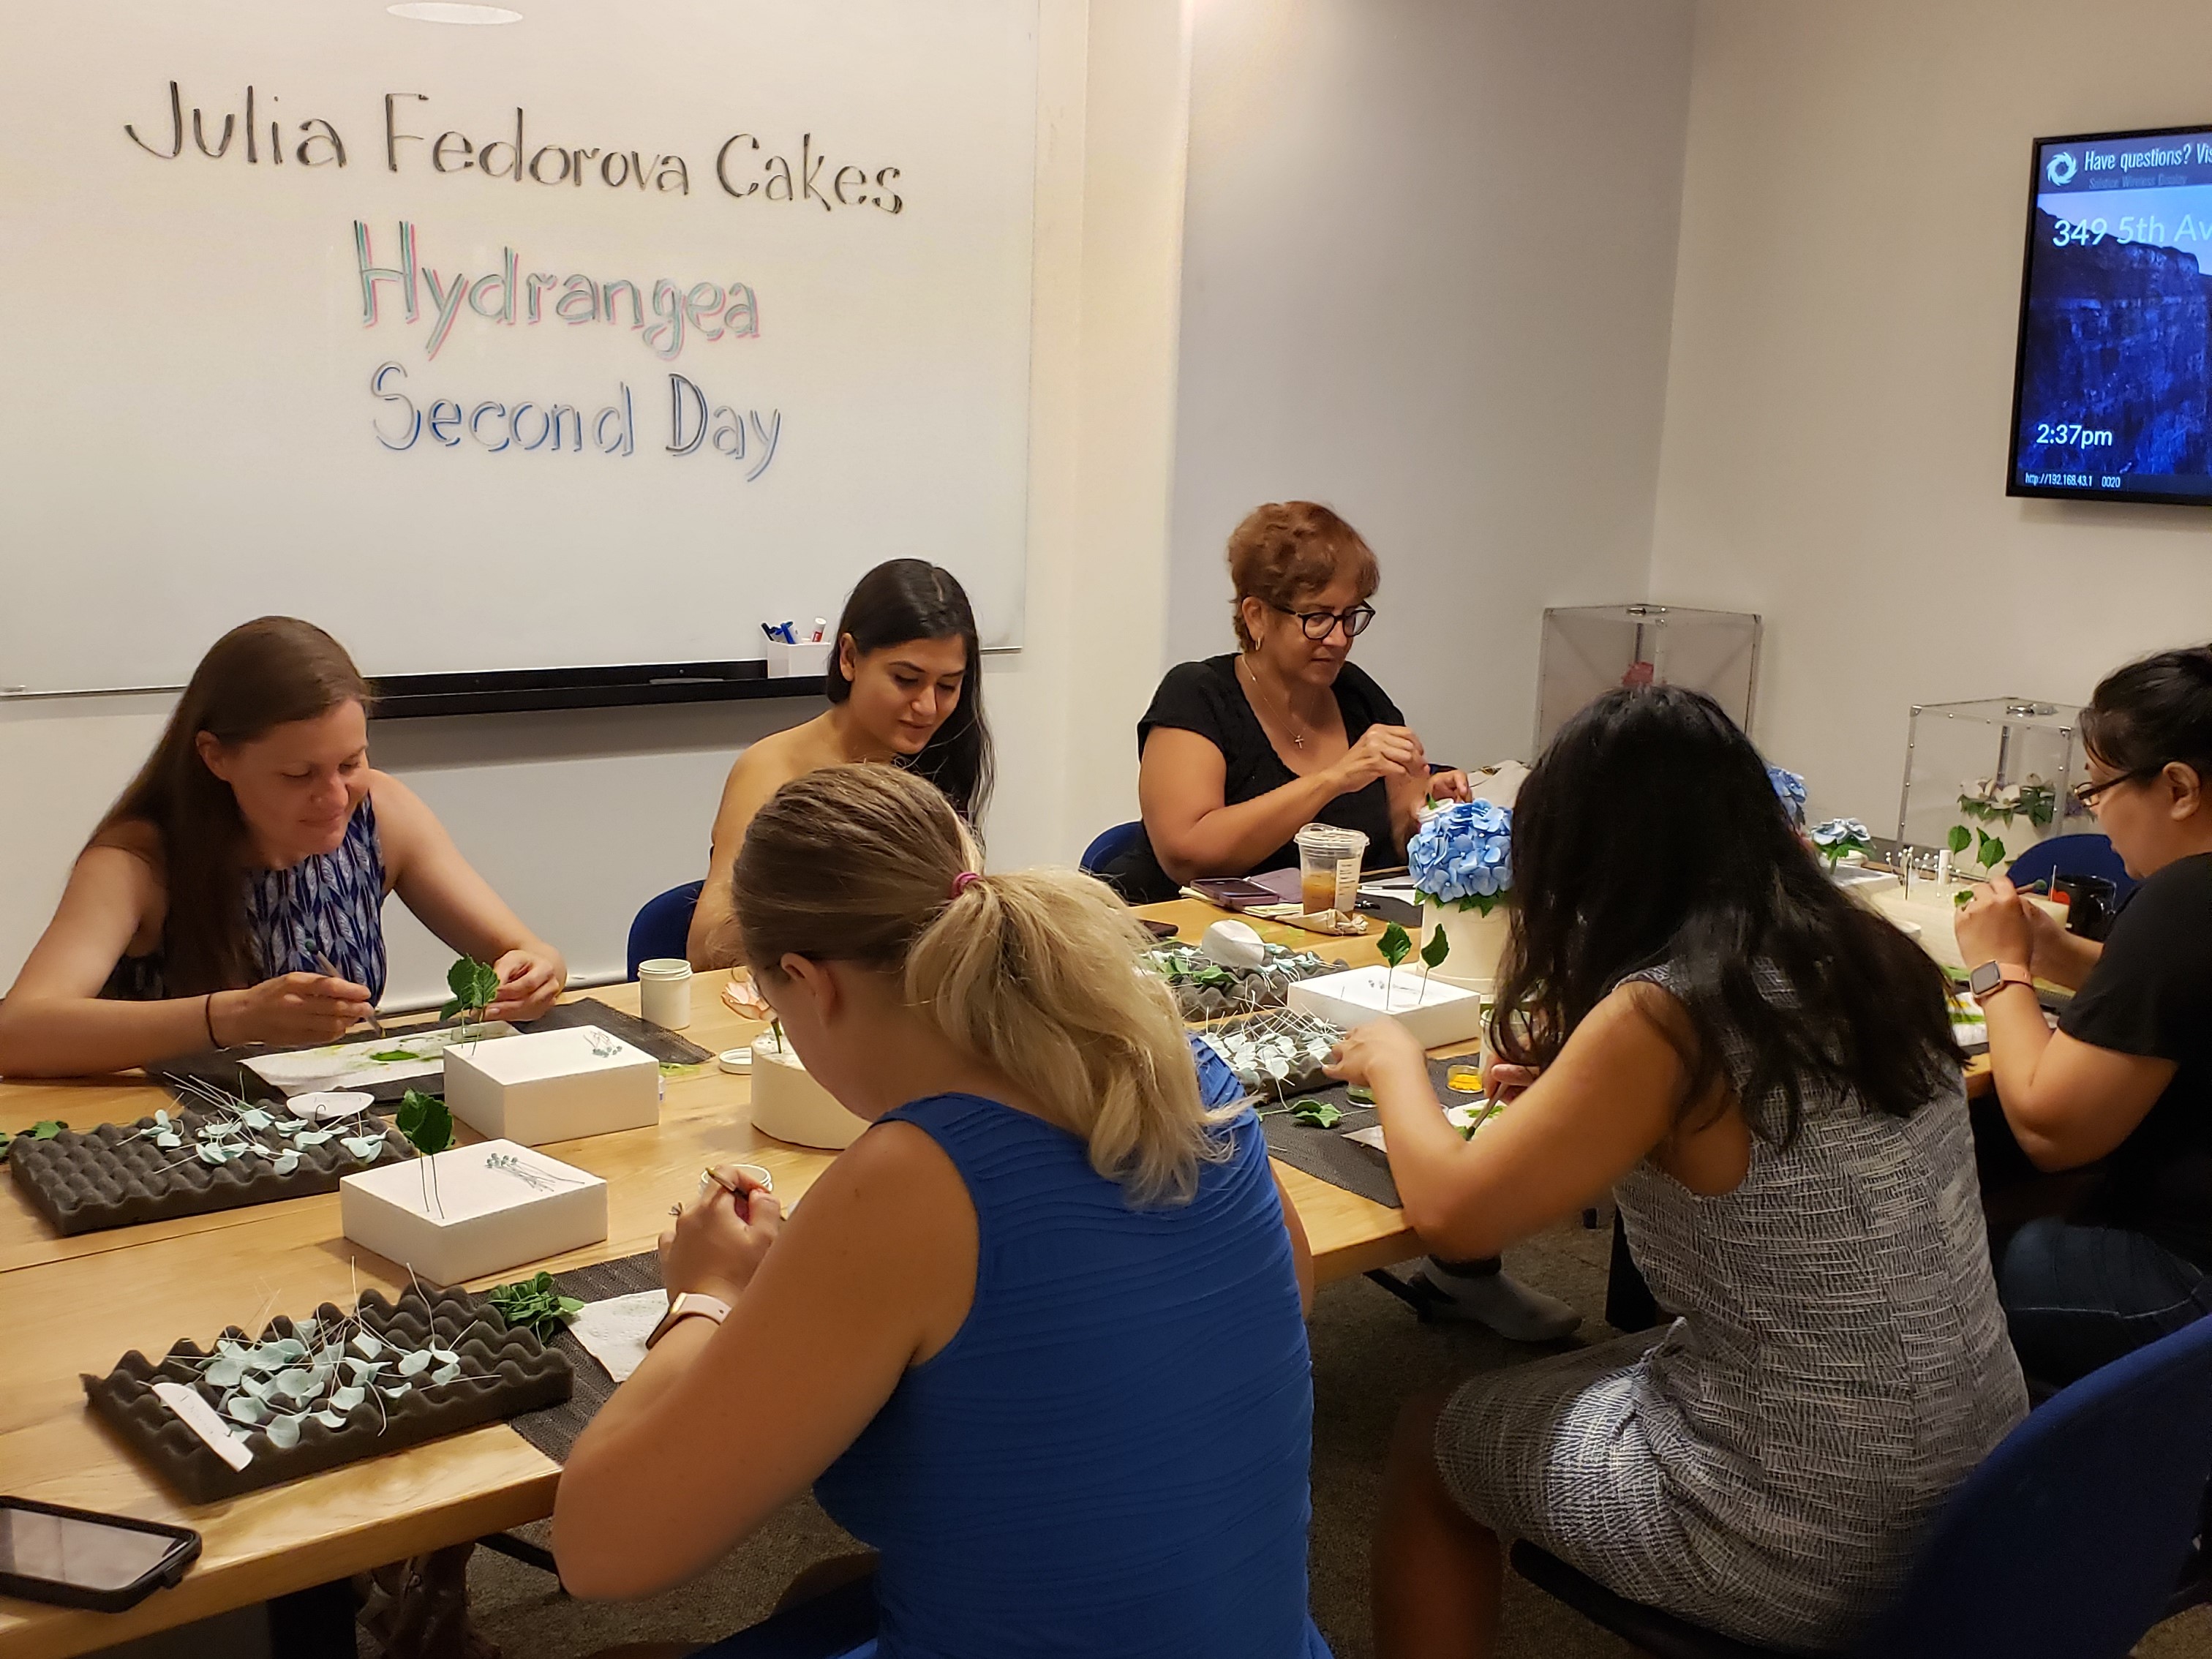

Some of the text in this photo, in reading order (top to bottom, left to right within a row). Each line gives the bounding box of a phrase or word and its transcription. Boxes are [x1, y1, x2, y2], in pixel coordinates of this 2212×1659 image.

[124, 80, 904, 215] Julia Fedorova Cakes
[2085, 151, 2115, 171] Have
[2121, 143, 2192, 173] questions?
[2053, 214, 2212, 247] 349 5th Av
[352, 219, 761, 361] Hydrangea
[371, 361, 783, 483] Second Day
[2036, 424, 2113, 449] 2:37pm
[2025, 473, 2121, 488] http://192.168.43.1 0020
